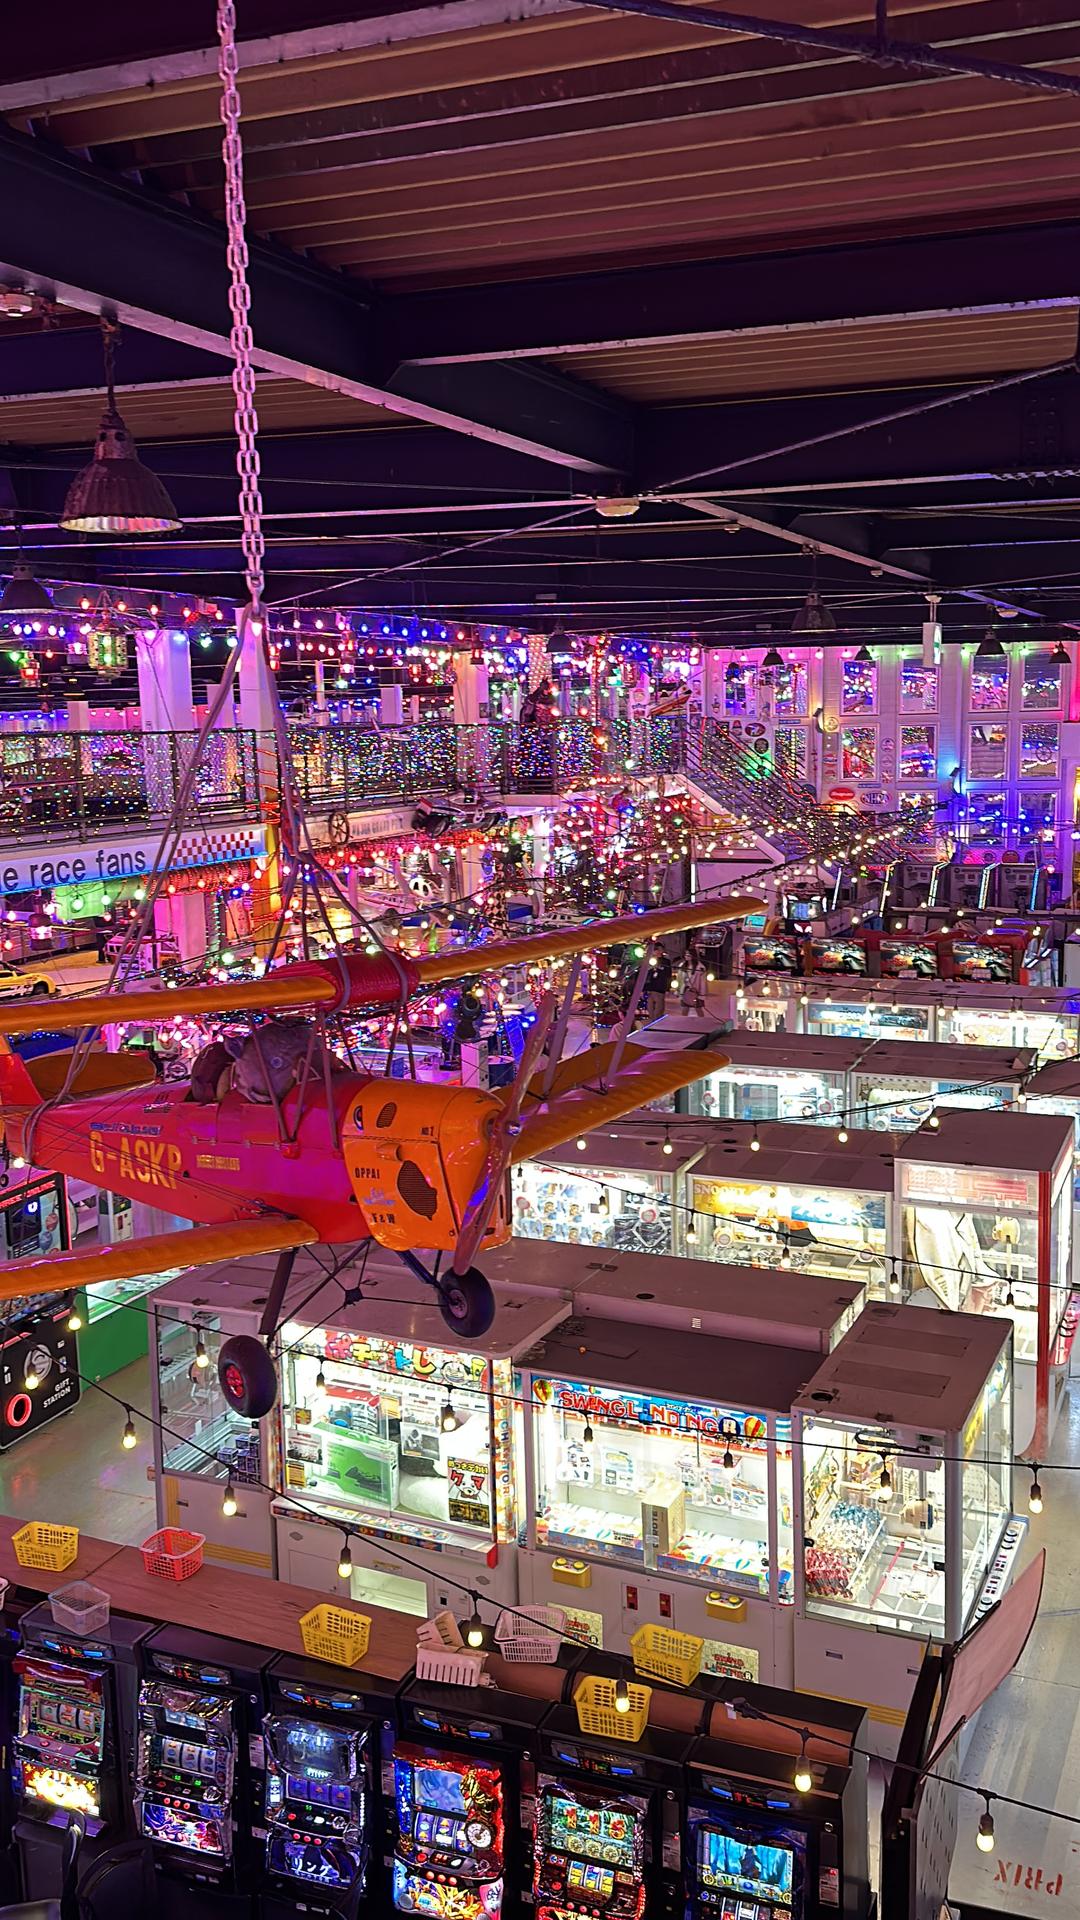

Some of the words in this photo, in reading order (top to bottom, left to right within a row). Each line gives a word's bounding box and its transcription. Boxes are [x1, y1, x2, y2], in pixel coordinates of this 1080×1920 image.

[30, 857, 86, 887] race
[96, 849, 146, 878] fans
[355, 1167, 380, 1179] OPPAI
[54, 1378, 70, 1392] GIFT
[43, 1386, 71, 1408] STATION
[292, 1857, 329, 1876] リング
[993, 1859, 1064, 1896] PRIX
